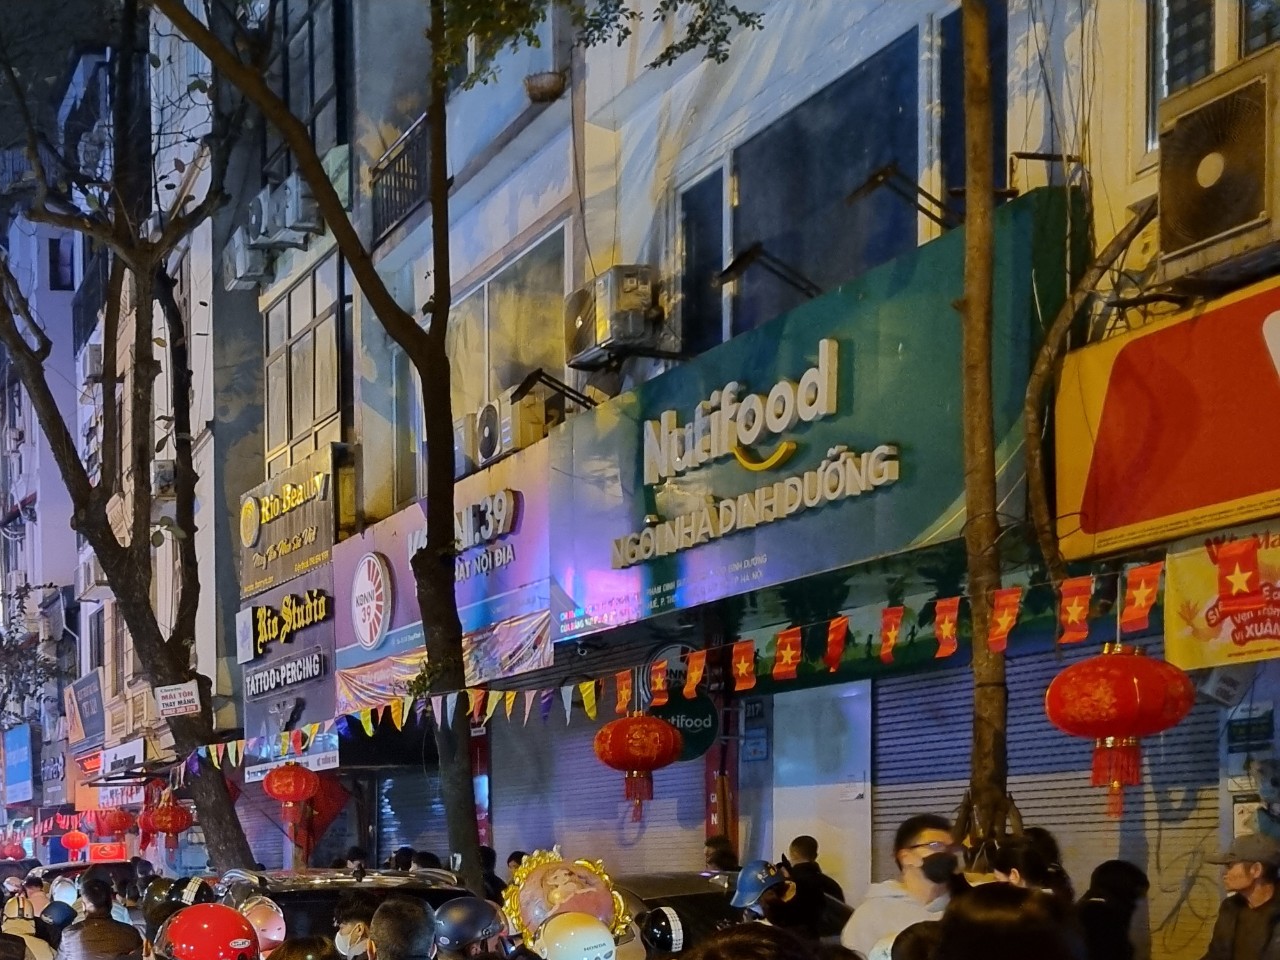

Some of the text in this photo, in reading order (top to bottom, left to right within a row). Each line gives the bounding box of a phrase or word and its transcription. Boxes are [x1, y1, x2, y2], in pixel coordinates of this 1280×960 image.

[643, 338, 838, 485] Nutifood
[260, 471, 327, 525] Rio Beauty
[280, 589, 327, 644] Studio
[584, 942, 607, 951] HONDA
